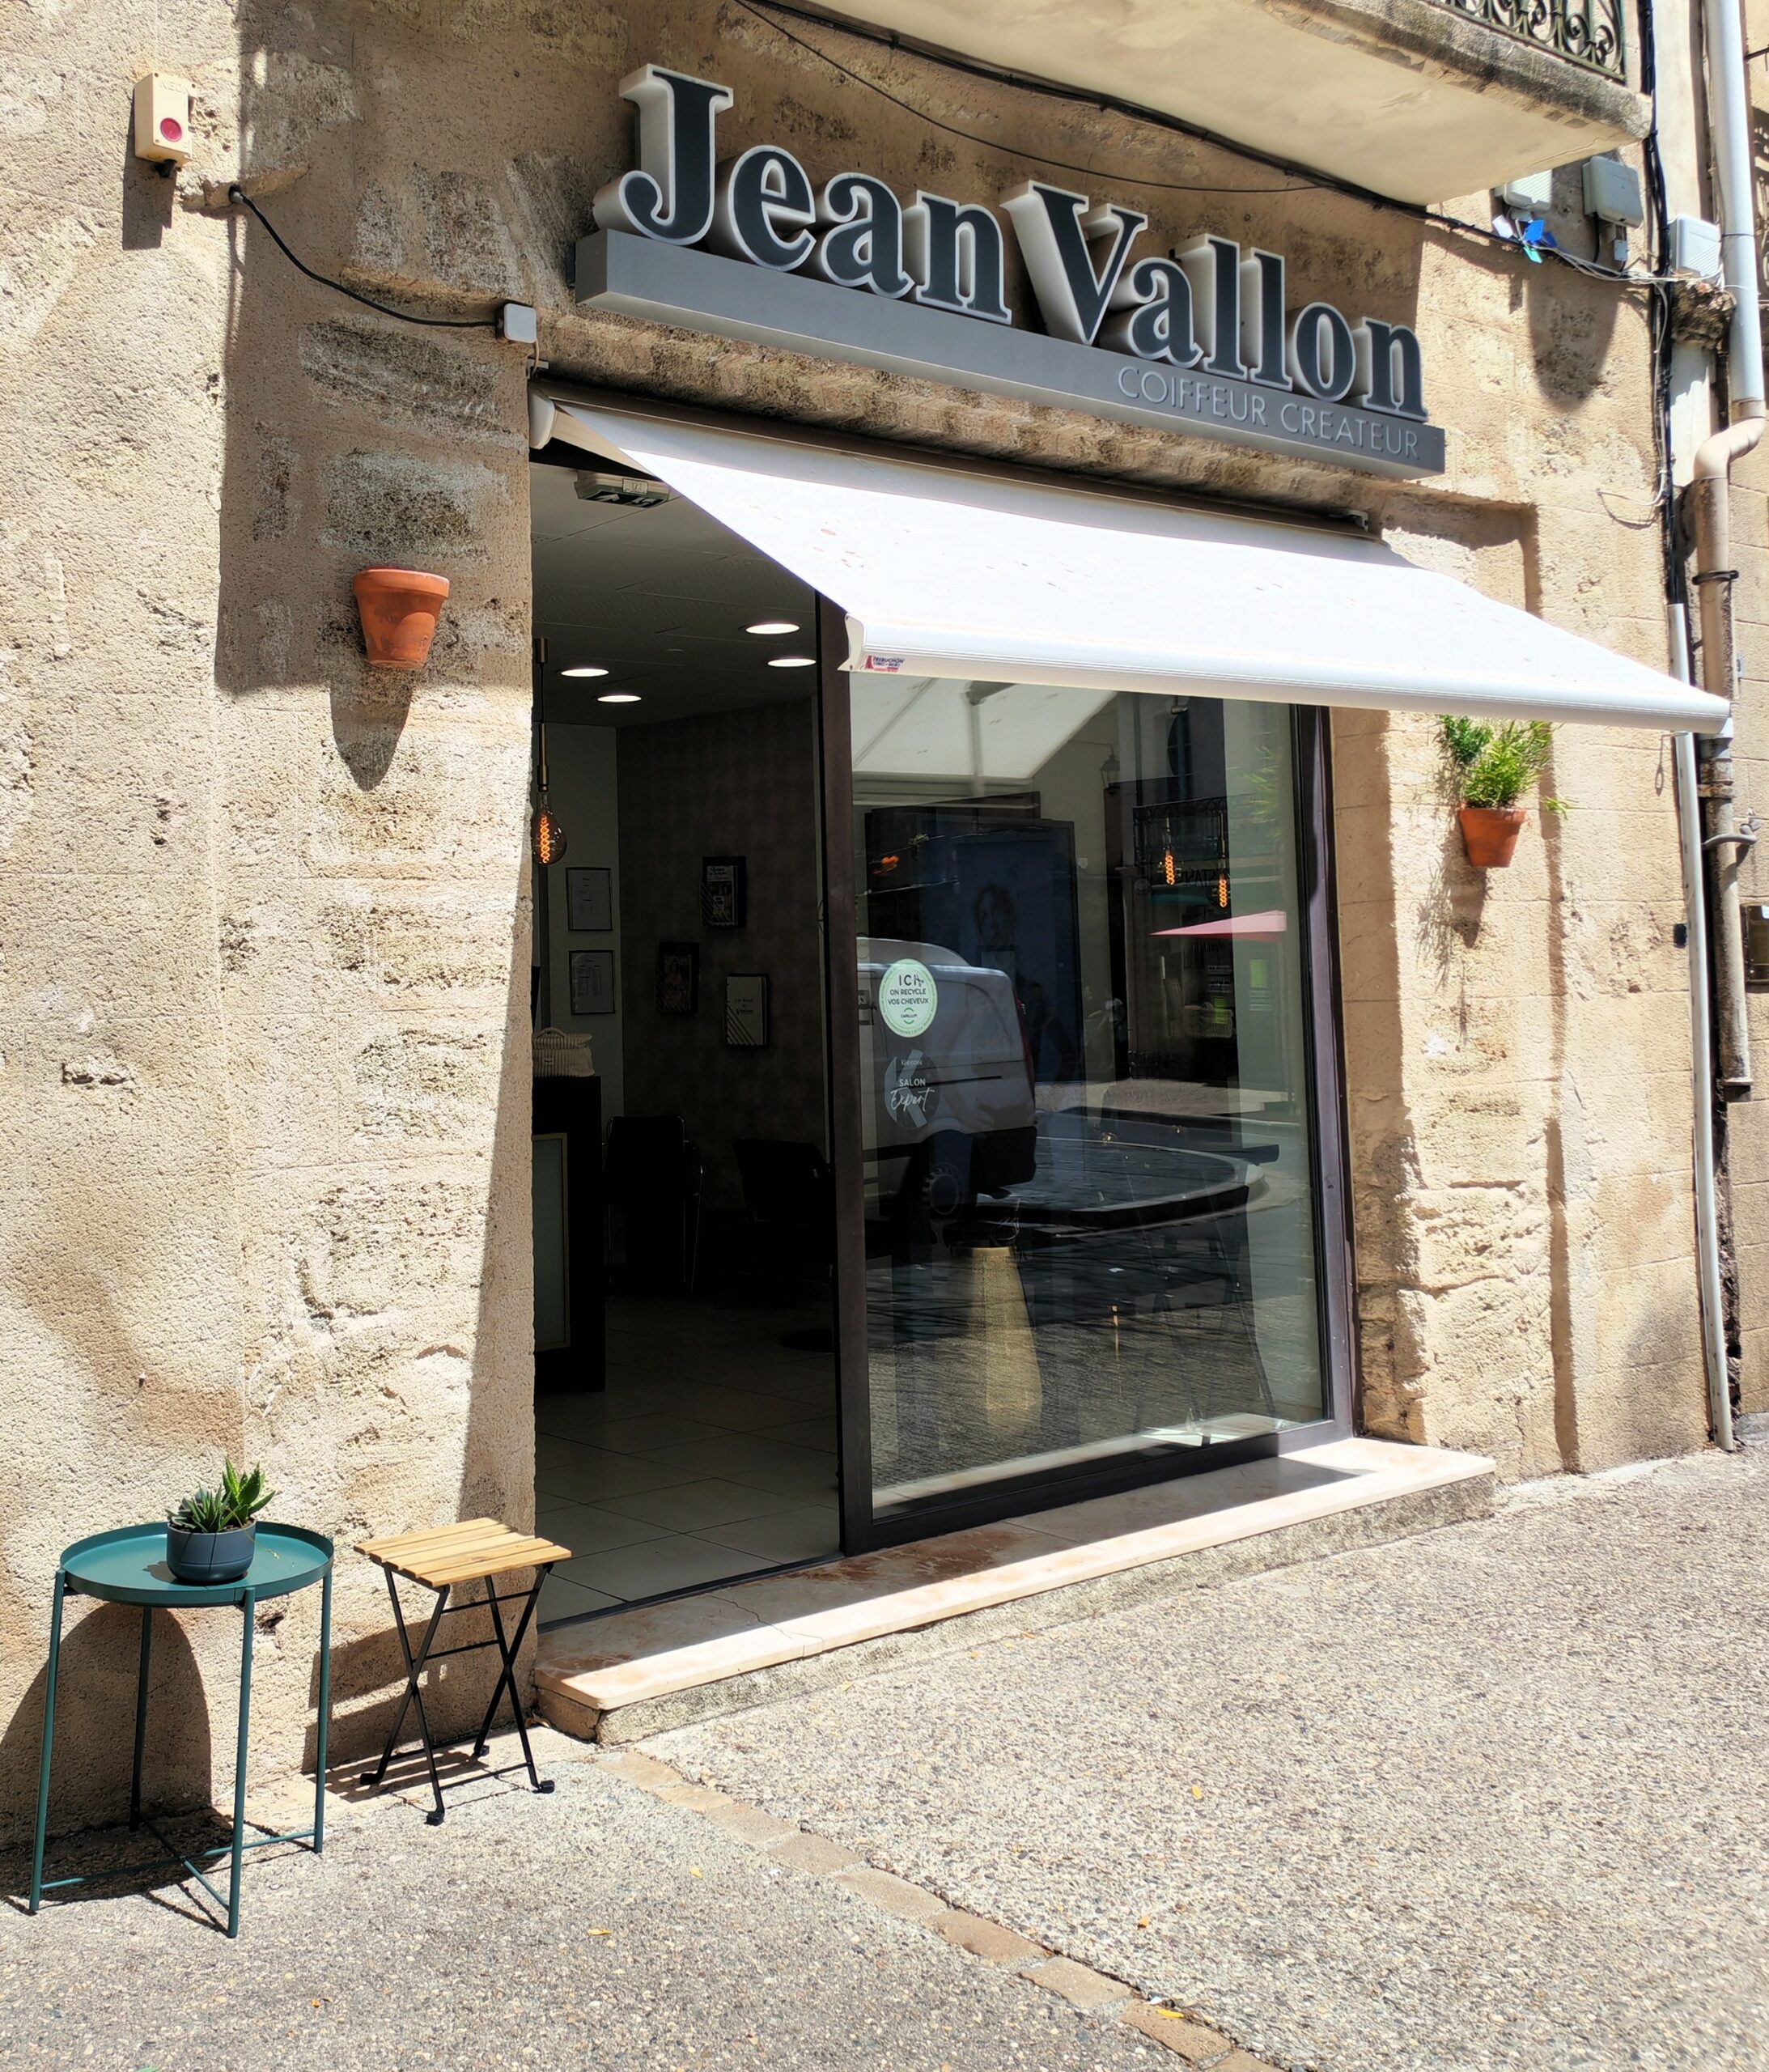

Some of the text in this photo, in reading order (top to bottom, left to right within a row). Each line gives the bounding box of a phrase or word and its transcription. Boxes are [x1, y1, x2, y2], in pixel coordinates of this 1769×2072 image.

[593, 63, 1428, 422] Jean Vallon
[1117, 365, 1420, 460] COIFFEUR CREATEUR
[898, 974, 917, 986] ICI
[901, 997, 929, 1005] CHEVEUX
[898, 1078, 926, 1087] SALON
[889, 1087, 935, 1113] Expert
